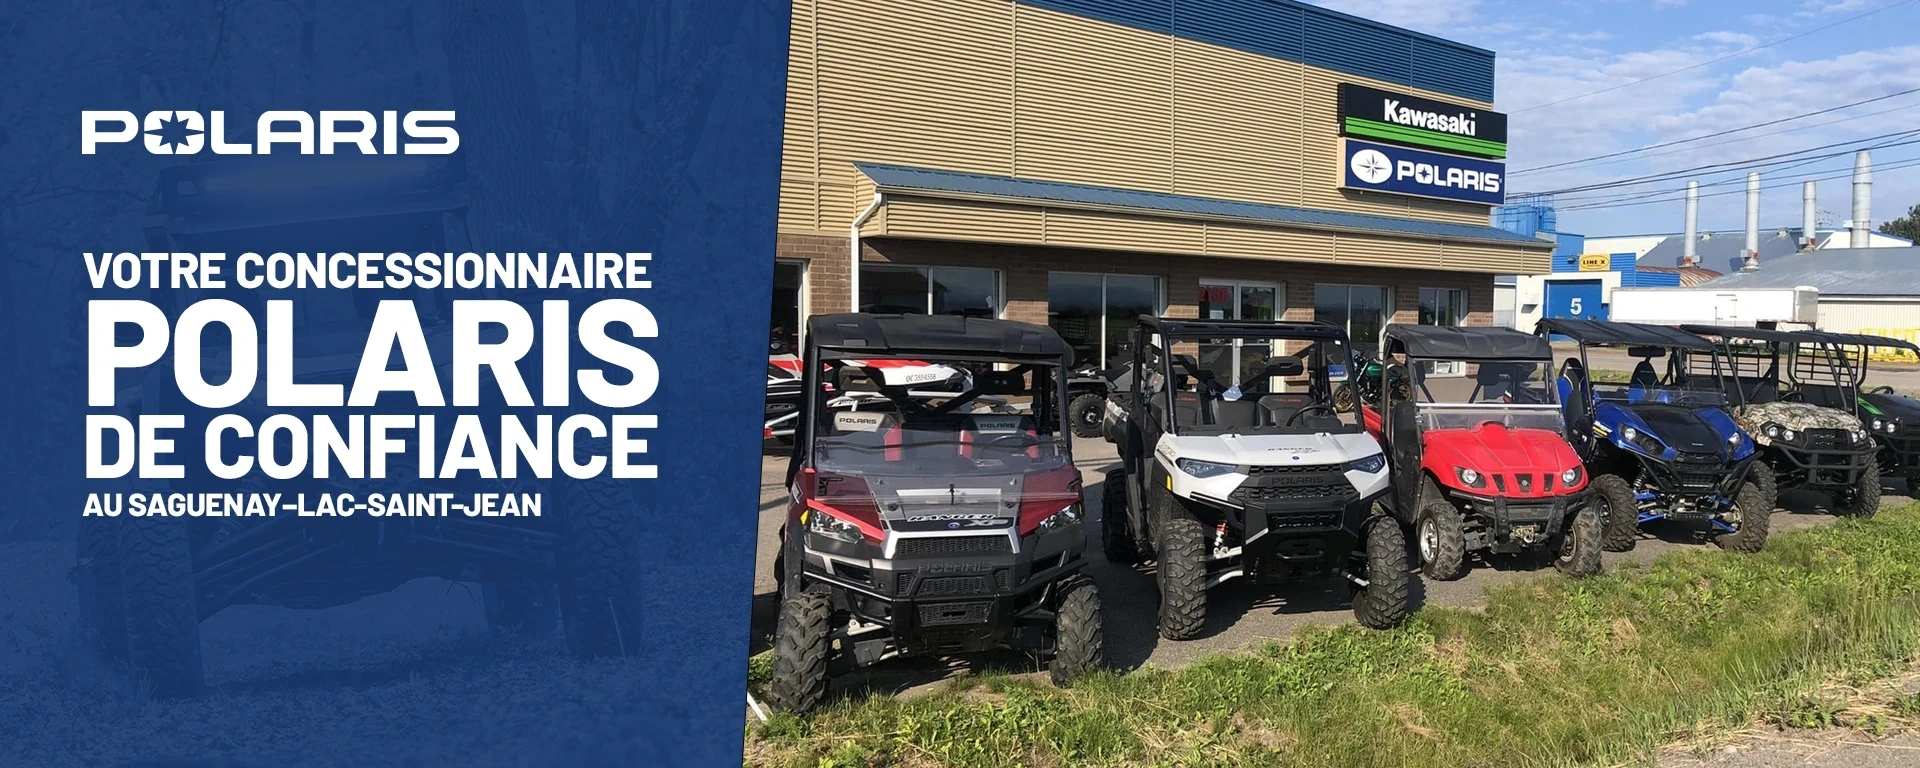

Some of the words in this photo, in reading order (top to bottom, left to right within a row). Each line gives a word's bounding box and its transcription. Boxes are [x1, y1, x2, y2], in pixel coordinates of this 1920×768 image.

[1384, 98, 1476, 136] Kawasaki
[1397, 160, 1500, 193] POLARIS
[1570, 297, 1582, 316] 5
[839, 416, 877, 425] POLARIS
[980, 422, 1016, 430] POLARIS
[1272, 475, 1324, 485] POLARIS
